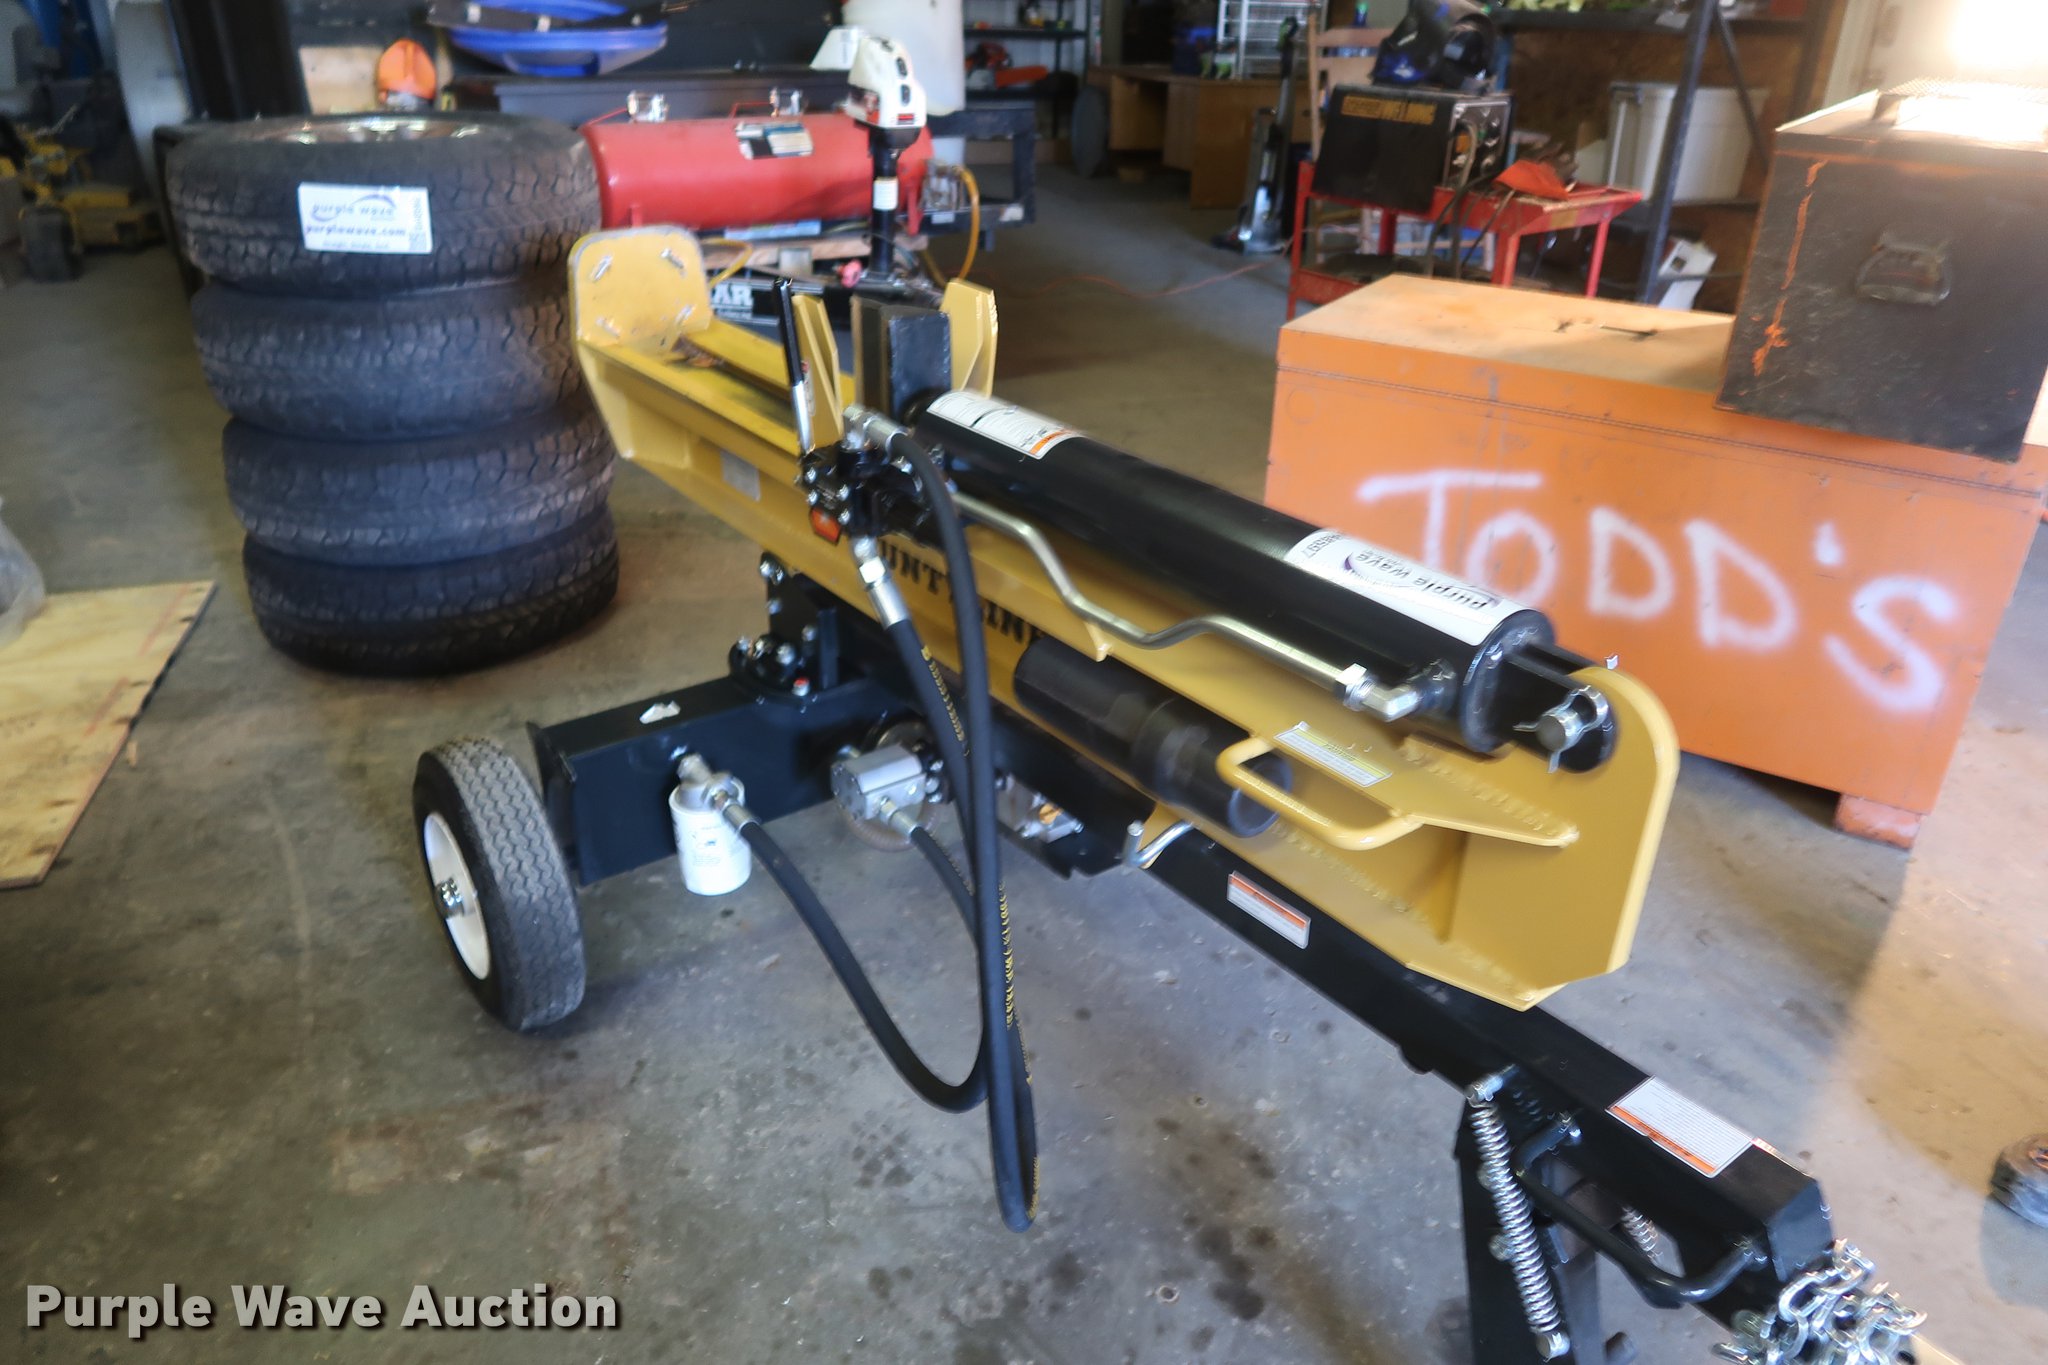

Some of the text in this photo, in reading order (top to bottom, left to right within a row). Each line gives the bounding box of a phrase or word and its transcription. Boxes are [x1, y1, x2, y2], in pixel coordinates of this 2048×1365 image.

[1356, 552, 1413, 579] wave
[1357, 468, 1962, 713] TODD'S
[1413, 577, 1489, 611] purple
